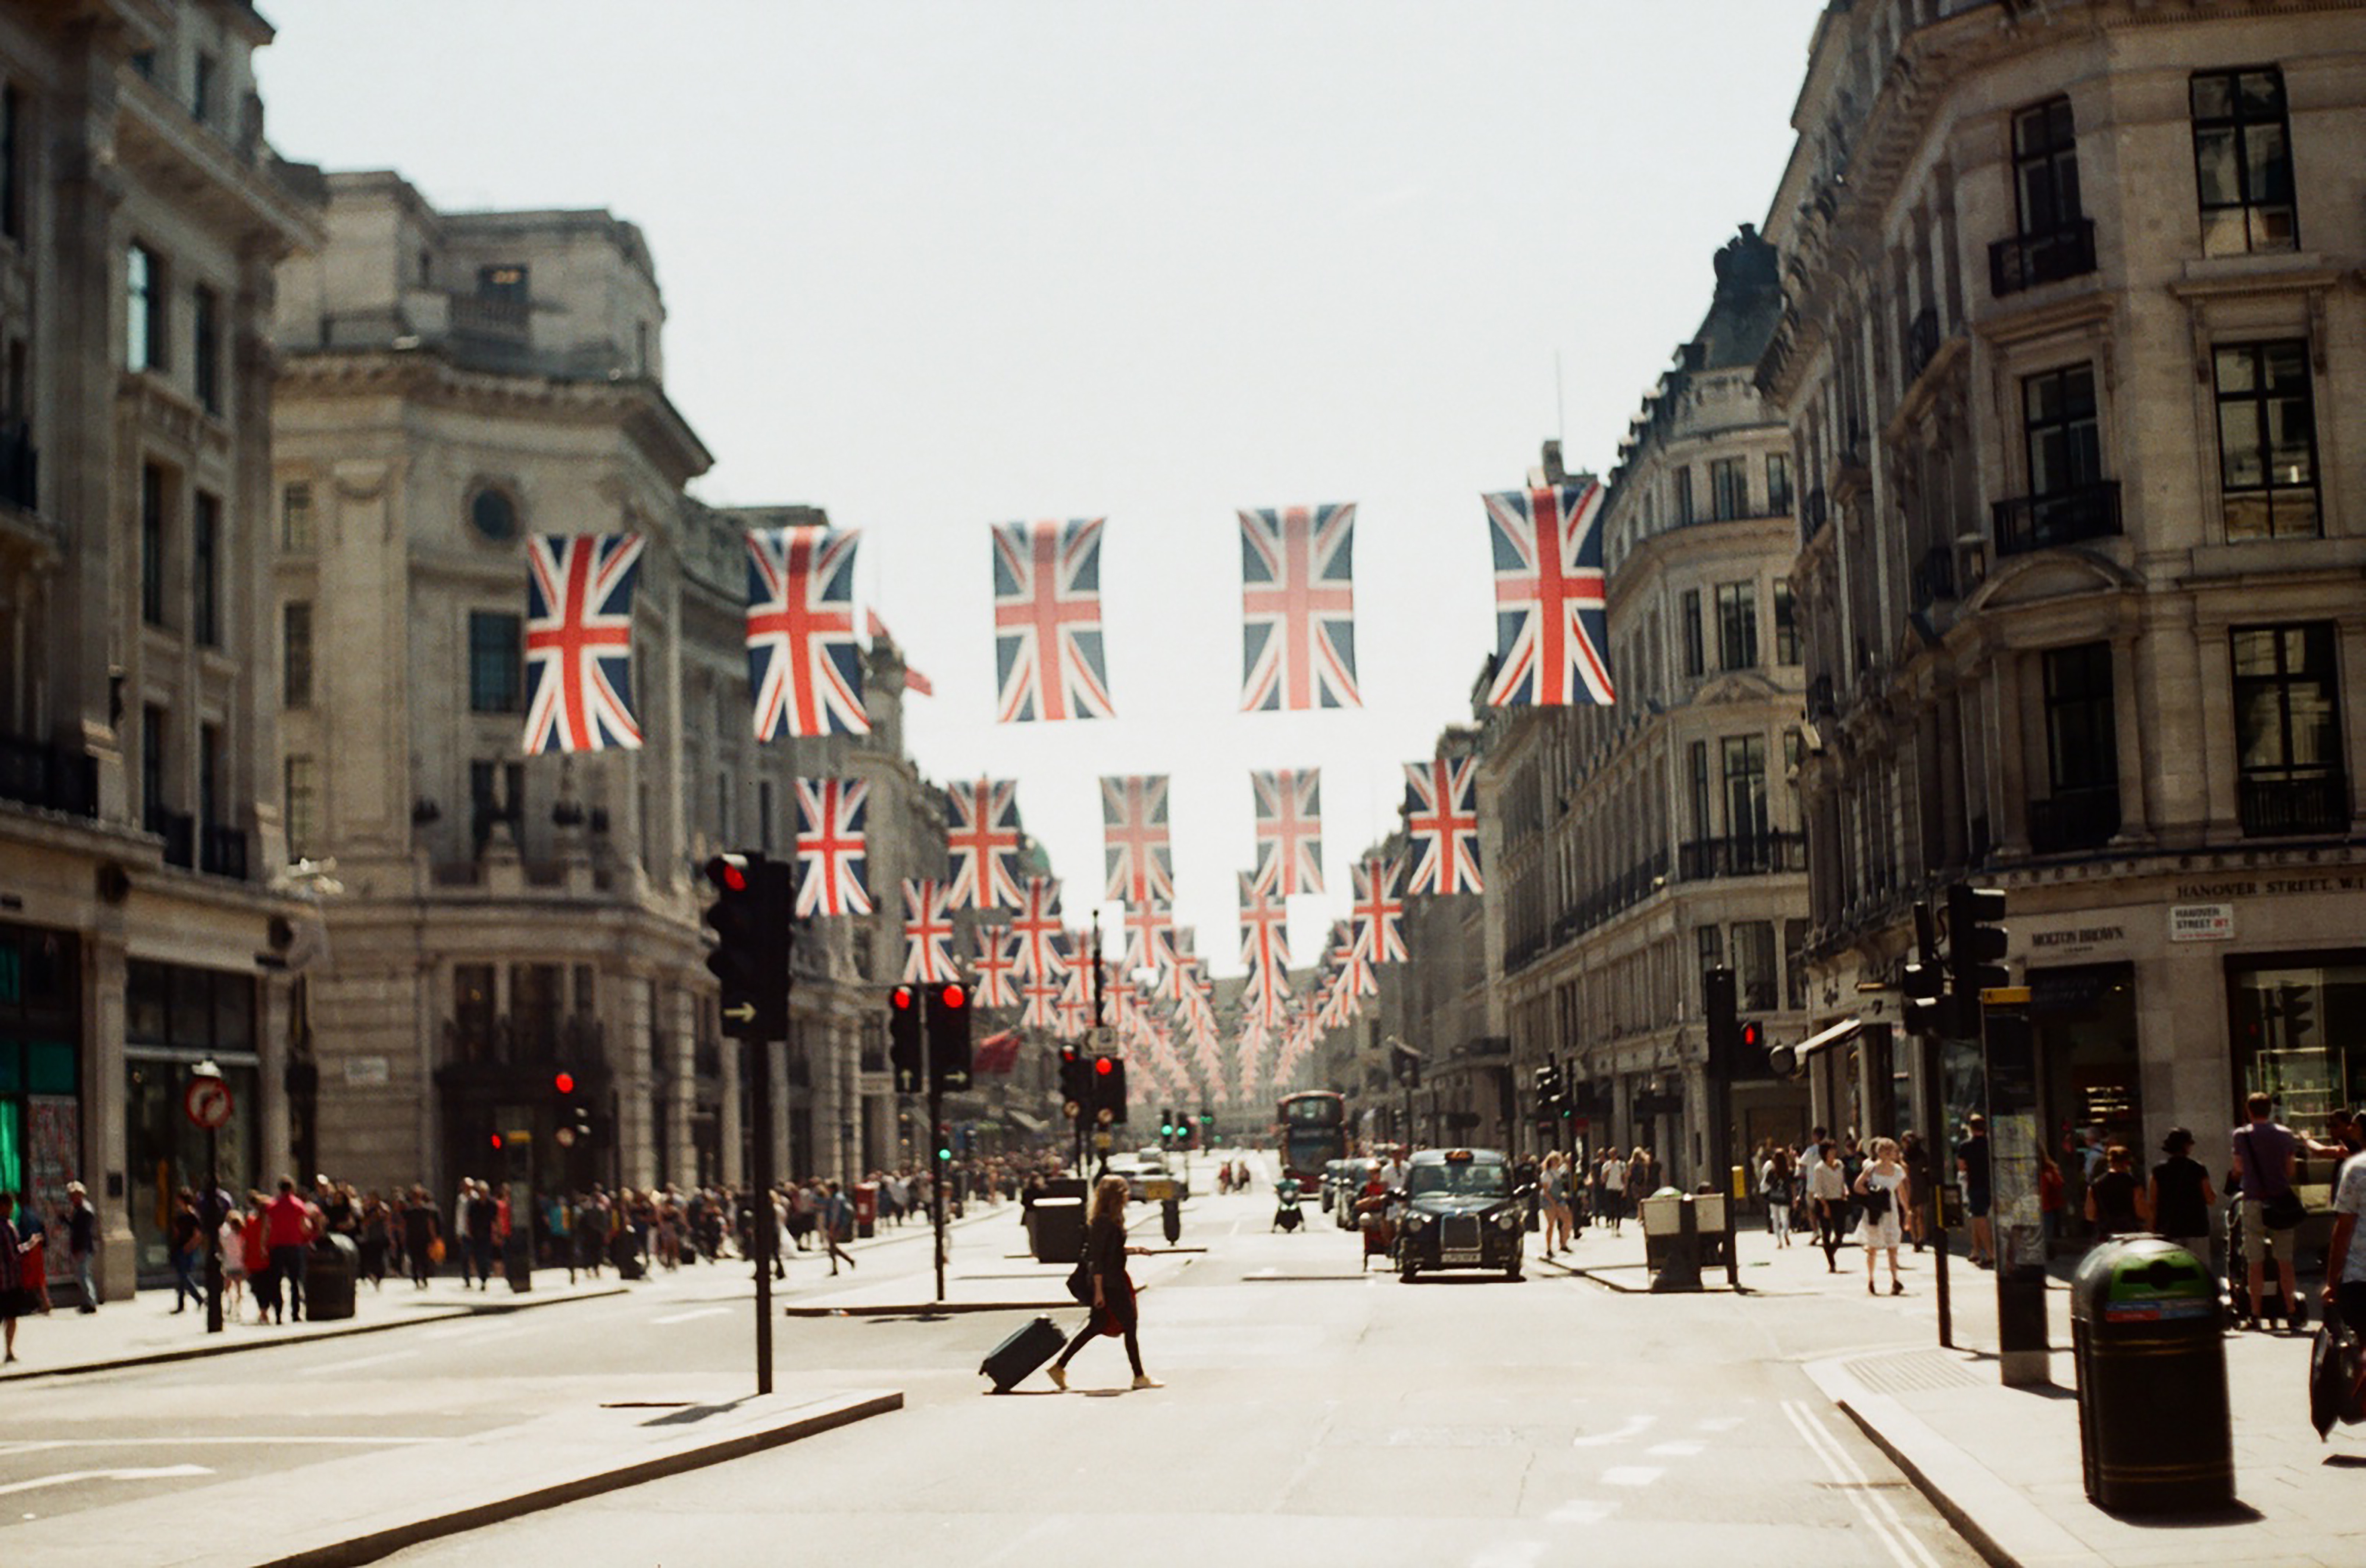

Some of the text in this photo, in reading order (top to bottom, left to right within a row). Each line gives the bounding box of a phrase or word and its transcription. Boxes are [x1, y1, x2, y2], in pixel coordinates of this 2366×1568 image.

[2177, 883, 2256, 898] HANOVER
[2176, 908, 2219, 917] HANOVER
[2177, 919, 2210, 929] STREET
[2033, 926, 2124, 947] MOLTON BROWN
